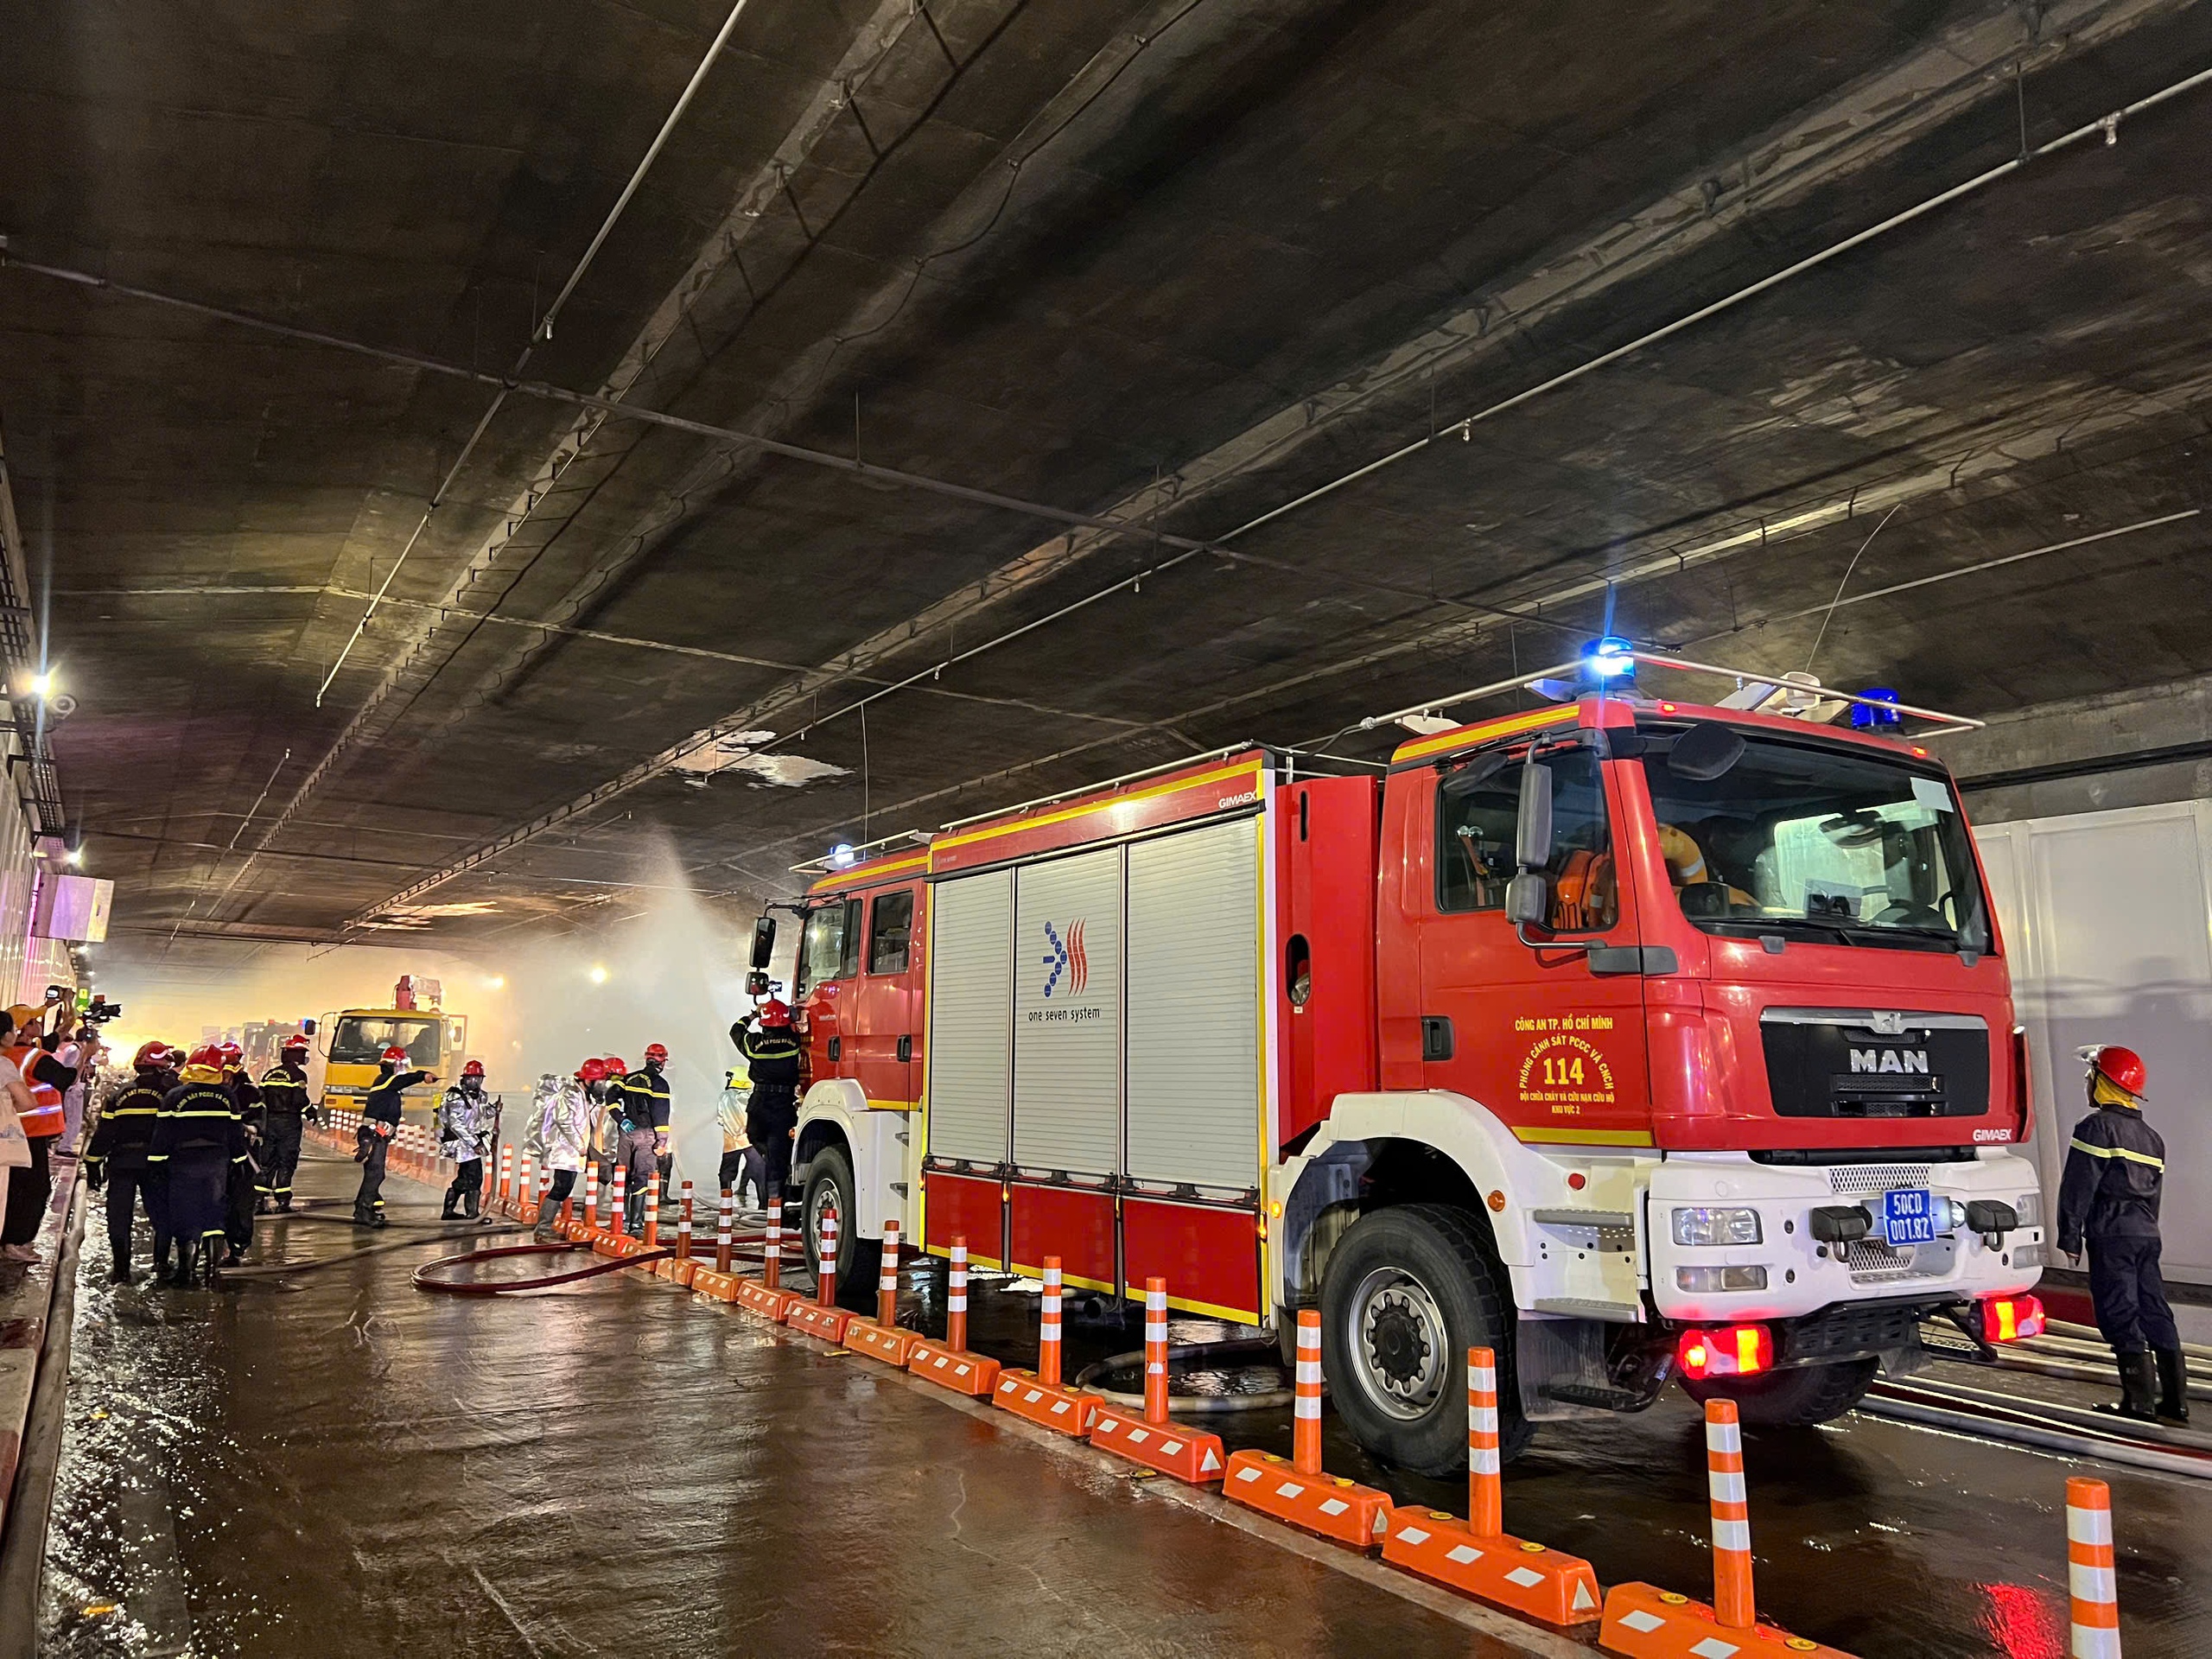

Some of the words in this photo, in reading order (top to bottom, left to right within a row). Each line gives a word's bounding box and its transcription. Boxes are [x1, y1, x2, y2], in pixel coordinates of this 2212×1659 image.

[1218, 791, 1256, 808] GIMAEX
[1028, 1011, 1042, 1021] one
[1046, 1010, 1067, 1020] seven
[1071, 1007, 1100, 1023] system
[1515, 1016, 1535, 1031] CÔNG
[1536, 1019, 1547, 1030] AN
[1548, 1019, 1560, 1030] TP.
[1575, 1014, 1590, 1030] CHÍ
[1519, 1057, 1534, 1089] PHÒNG
[1551, 1033, 1567, 1046] SÁT
[1568, 1035, 1591, 1053] PCCC
[1589, 1049, 1604, 1064] VÀ
[1599, 1063, 1614, 1090] CNCH
[1850, 1049, 1929, 1073] MAN
[1543, 1058, 1585, 1085] 114
[1575, 1105, 1580, 1115] 2
[1973, 1128, 2012, 1141] GIMAEX
[1893, 1192, 1923, 1215] 50CD
[1890, 1217, 1930, 1241] 001.82
